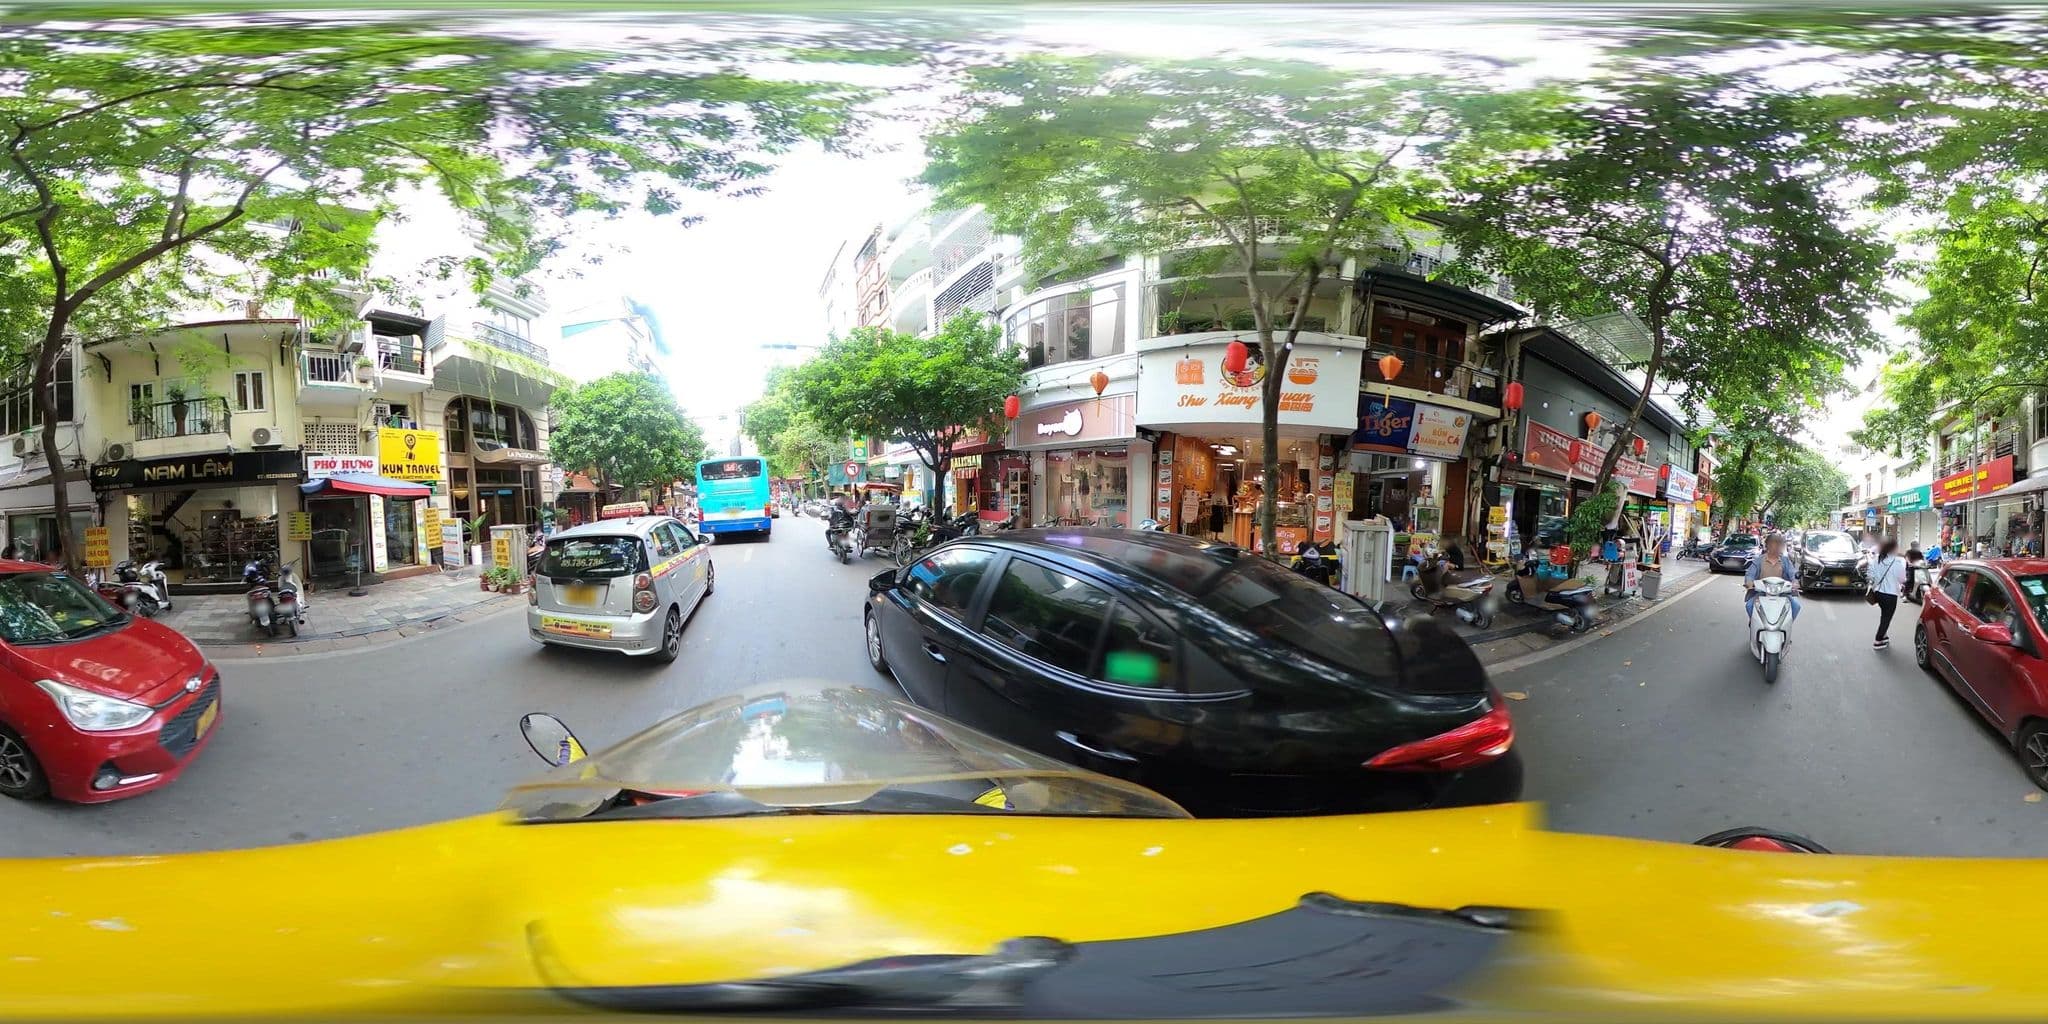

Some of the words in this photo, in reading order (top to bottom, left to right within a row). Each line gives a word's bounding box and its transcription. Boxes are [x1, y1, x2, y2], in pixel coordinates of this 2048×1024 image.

[1177, 394, 1208, 407] Shu
[1213, 392, 1260, 410] Xiang
[1362, 410, 1411, 437] Tiger
[144, 464, 185, 481] NAM
[192, 459, 234, 478] LÂM
[313, 457, 338, 469] PHỞ
[342, 459, 374, 469] HƯNG
[382, 463, 404, 473] KUN
[406, 464, 441, 474] TRAVEL
